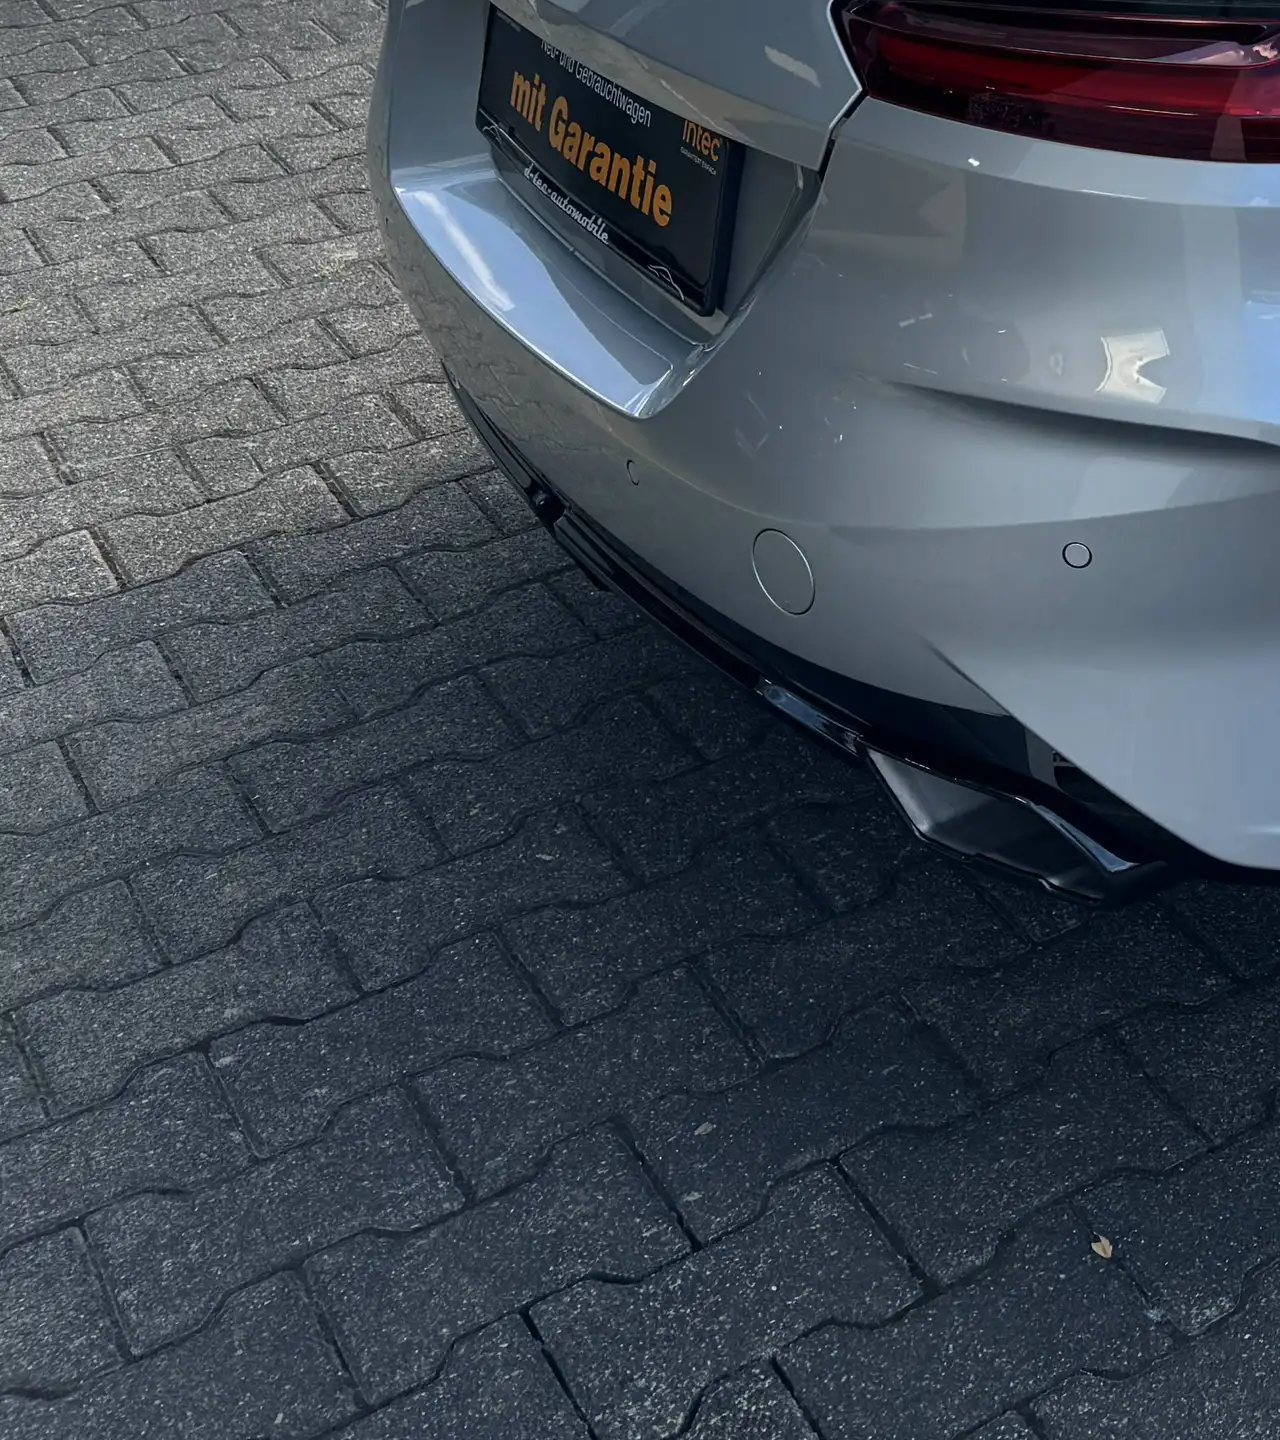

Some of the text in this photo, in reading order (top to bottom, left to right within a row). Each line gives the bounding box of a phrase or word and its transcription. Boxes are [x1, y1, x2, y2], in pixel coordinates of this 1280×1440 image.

[510, 70, 673, 228] mit Garantie
[575, 62, 652, 128] Gebrauchtwagen
